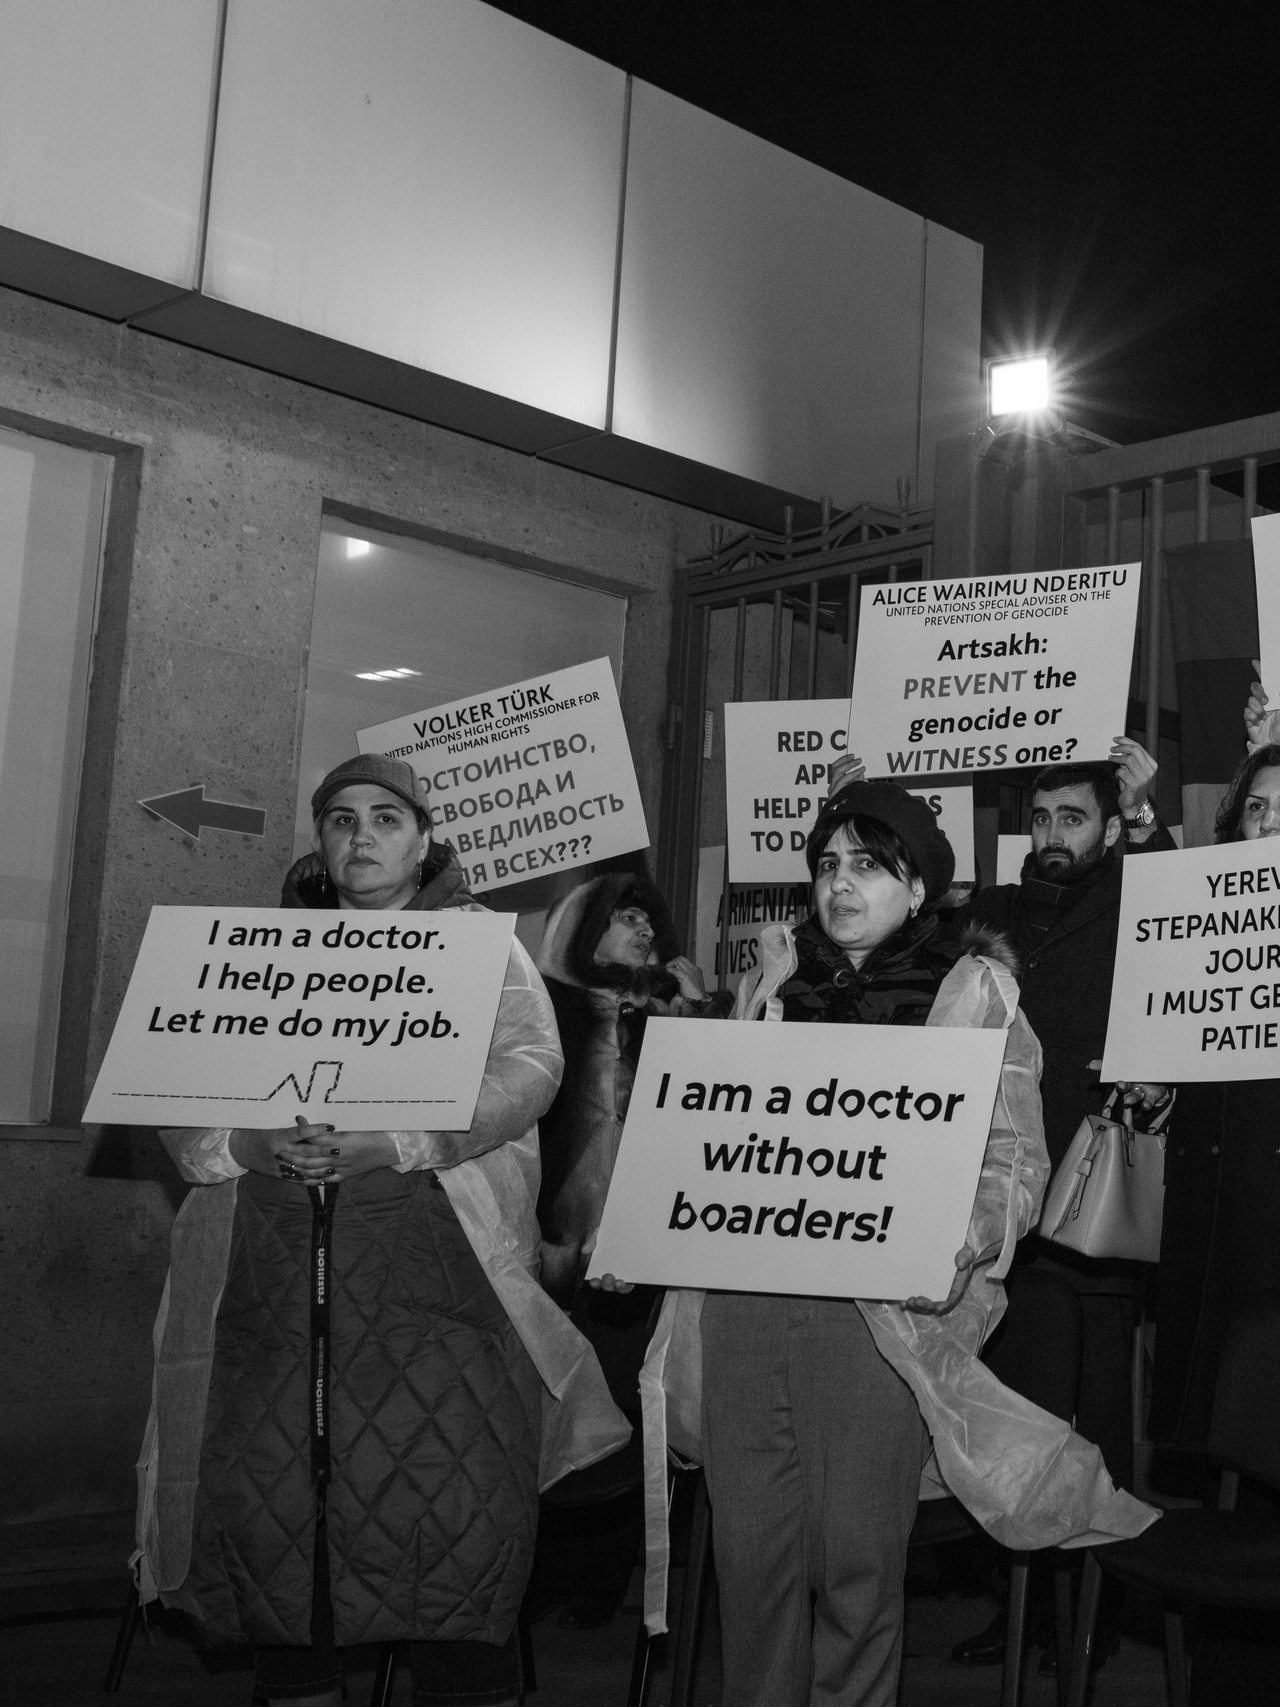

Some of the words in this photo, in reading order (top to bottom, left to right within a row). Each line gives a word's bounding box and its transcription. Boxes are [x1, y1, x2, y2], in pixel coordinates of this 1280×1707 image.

[872, 586, 927, 606] ALICE
[932, 578, 1028, 602] WAIRIMU
[1033, 569, 1128, 594] NDERITU
[885, 605, 926, 618] UNITED
[927, 601, 977, 614] NATIONS
[978, 598, 1020, 611] SPECIAL
[1021, 593, 1067, 607] ADVISER
[1069, 592, 1088, 603] ON
[1090, 589, 1111, 601] THE
[924, 612, 992, 627] PREVENTION
[993, 610, 1009, 622] OF
[1010, 605, 1069, 620] GENOCIDE
[937, 631, 1048, 662] Artsakh:
[903, 669, 1028, 700] PREVENT
[1033, 666, 1077, 690] the
[381, 744, 415, 760] NITED
[414, 730, 464, 753] NATIONS
[463, 721, 494, 738] HIGH
[494, 700, 577, 731] COMMISSIONER
[577, 691, 600, 706] FOR
[413, 701, 496, 739] VOLKER
[496, 683, 556, 716] TÜRK
[907, 705, 1027, 743] genocide
[1033, 707, 1063, 726] or
[447, 733, 490, 756] HUMAN
[490, 723, 531, 743] RIGHTS
[777, 730, 824, 753] RED
[886, 743, 1008, 774] WITNESS
[1015, 737, 1078, 765] one?
[417, 732, 597, 796] ОСТОИНСТВО,
[429, 777, 552, 827] СВОБОДА
[555, 770, 576, 793] И
[753, 797, 812, 820] HELP
[493, 834, 592, 879] ВСЕХ???
[750, 830, 784, 852] TO
[208, 919, 221, 946] I
[227, 926, 283, 947] am
[291, 928, 312, 948] a
[321, 920, 445, 951] doctor.
[197, 963, 210, 989] I
[217, 962, 295, 1000] help
[301, 965, 434, 1002] people.
[1146, 992, 1154, 1016] I
[1162, 986, 1244, 1016] MUST
[148, 1006, 206, 1034] Let
[212, 1014, 269, 1036] me
[278, 1008, 323, 1037] do
[331, 1017, 390, 1047] my
[390, 1010, 460, 1047] job.
[655, 1072, 671, 1109] I
[680, 1082, 753, 1113] am
[765, 1085, 792, 1115] a
[805, 1077, 966, 1123] doctor
[703, 1132, 887, 1181] without
[667, 1190, 894, 1244] boarders!
